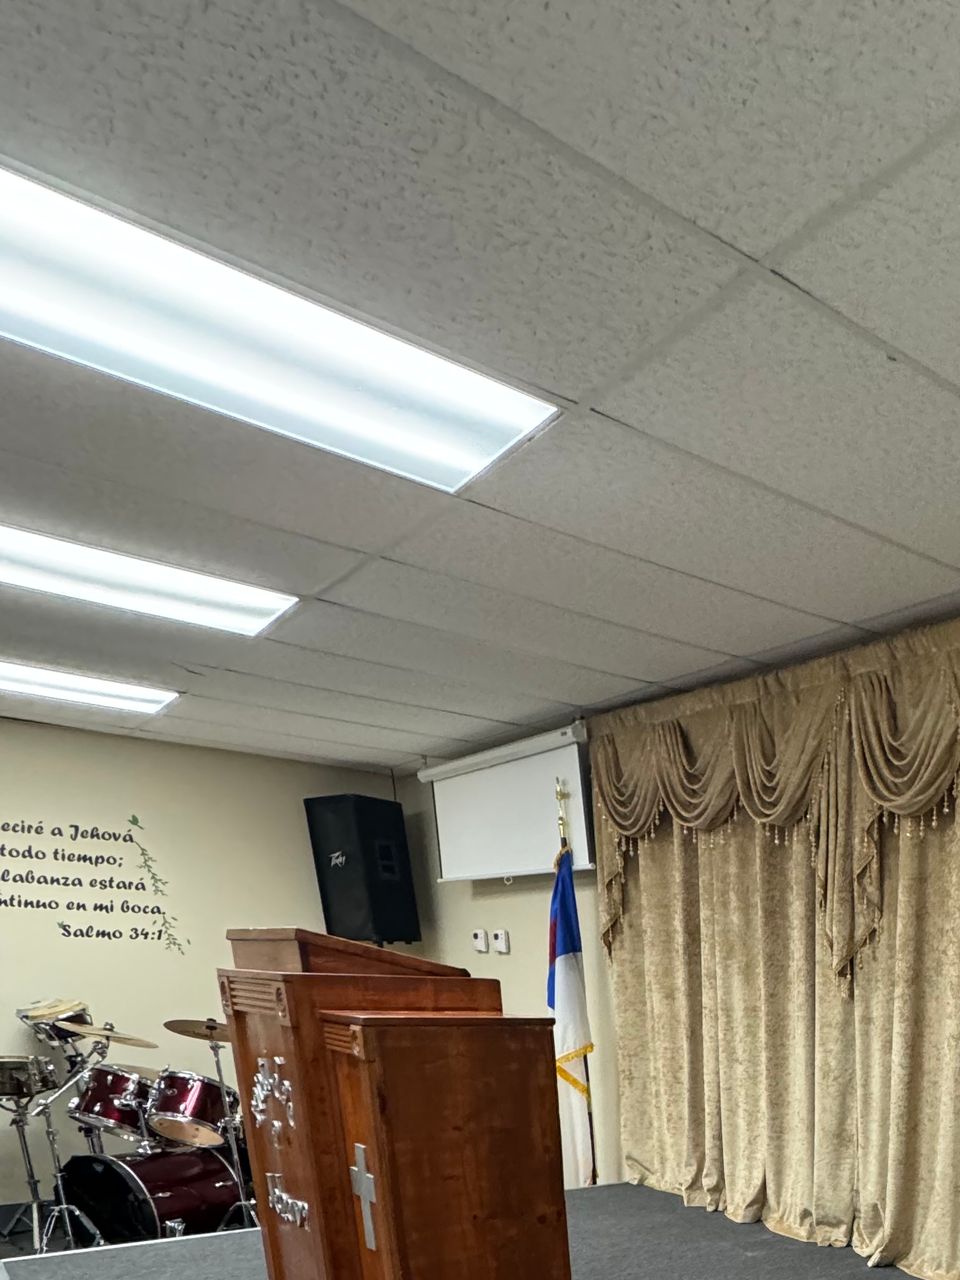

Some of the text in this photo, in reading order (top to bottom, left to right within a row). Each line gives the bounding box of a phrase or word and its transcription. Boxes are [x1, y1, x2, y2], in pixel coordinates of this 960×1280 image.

[51, 827, 63, 837] a
[69, 825, 134, 843] Jehová
[0, 844, 124, 867] todo tiempo;
[89, 877, 146, 891] estará
[66, 901, 87, 911] en
[93, 900, 114, 914] mi
[120, 900, 166, 915] boca.
[61, 924, 163, 941] Salmo 34:1
